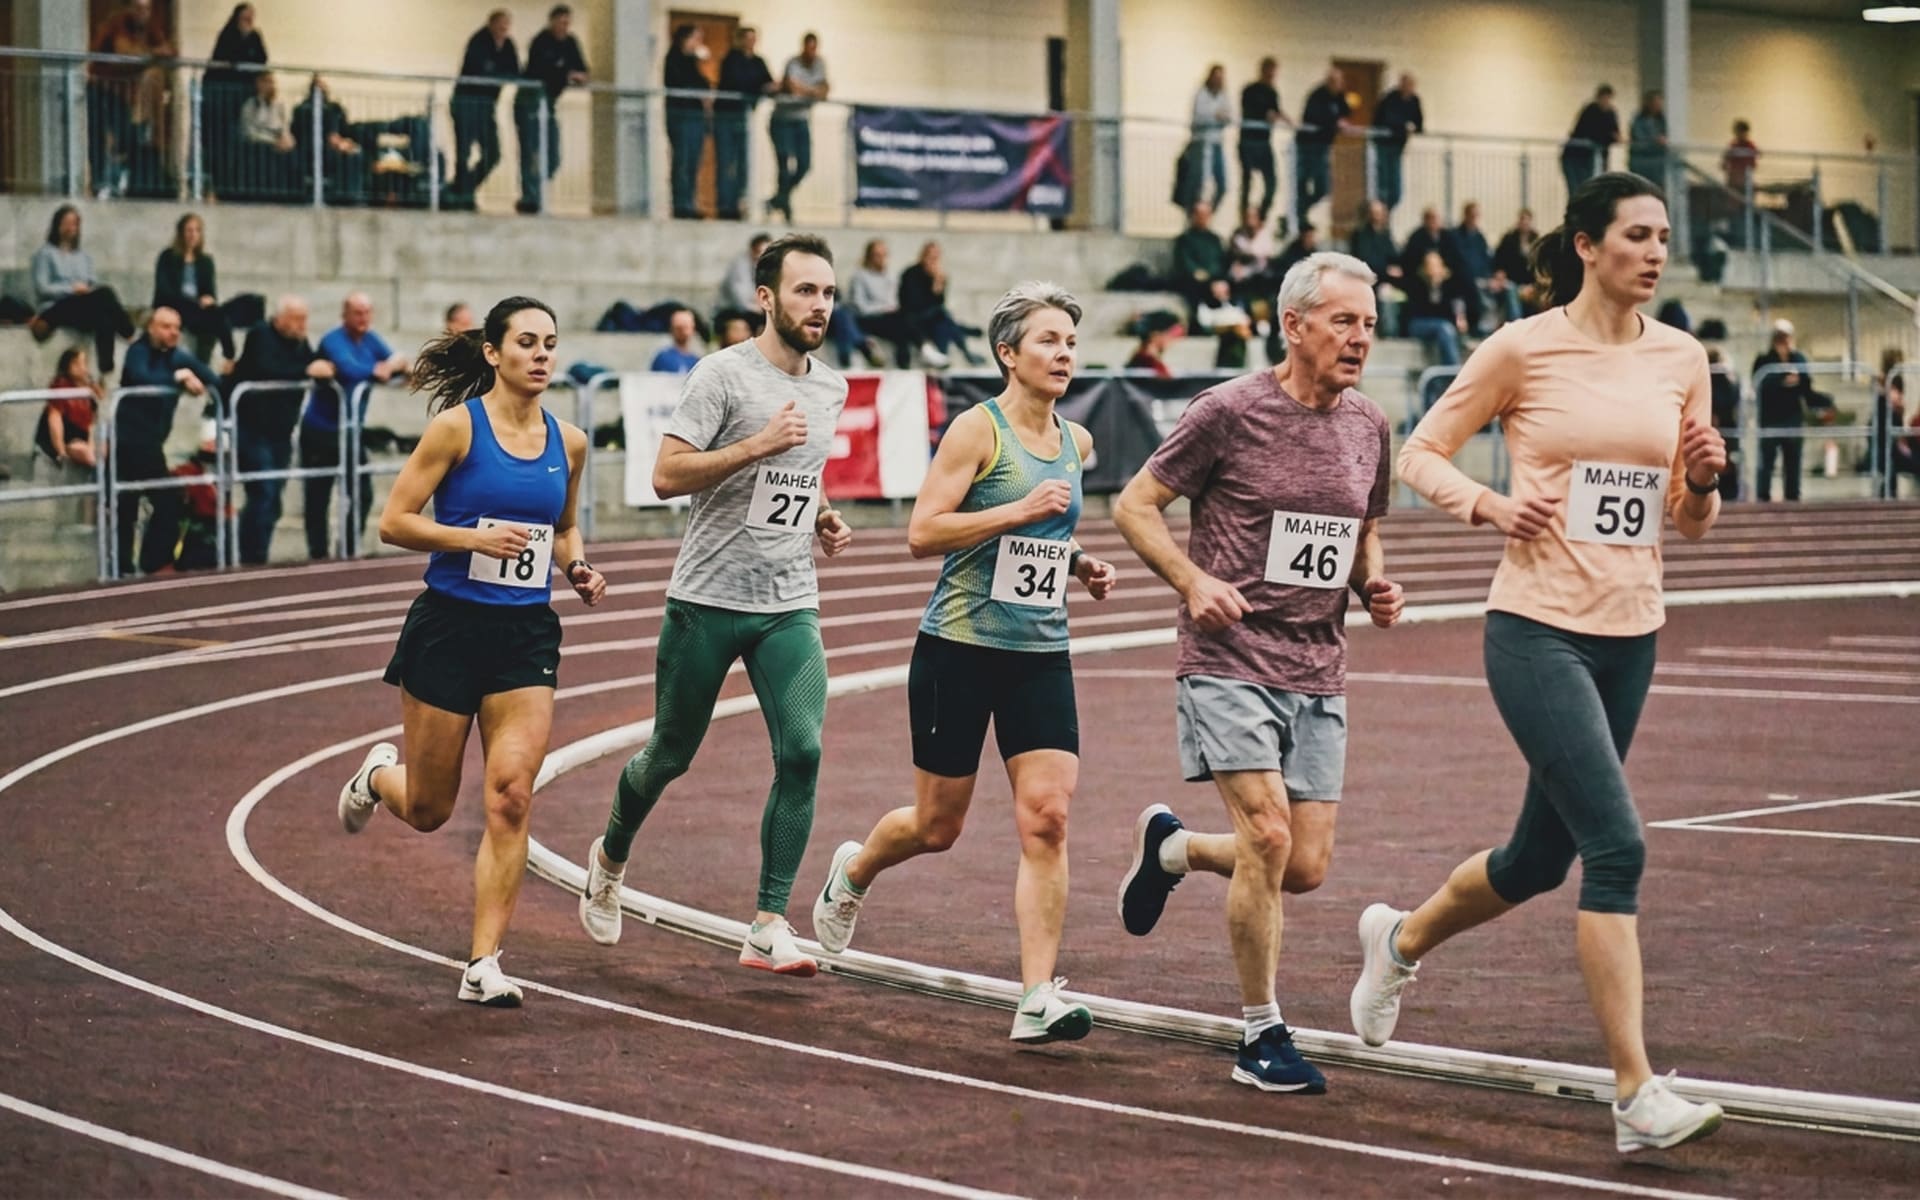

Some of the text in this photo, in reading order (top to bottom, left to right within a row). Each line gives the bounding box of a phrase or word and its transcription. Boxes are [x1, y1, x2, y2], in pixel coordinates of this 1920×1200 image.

[766, 493, 810, 527] 27
[1595, 495, 1645, 537] 59
[499, 548, 535, 581] 18
[1289, 543, 1339, 581] 46
[1014, 563, 1057, 599] 34
